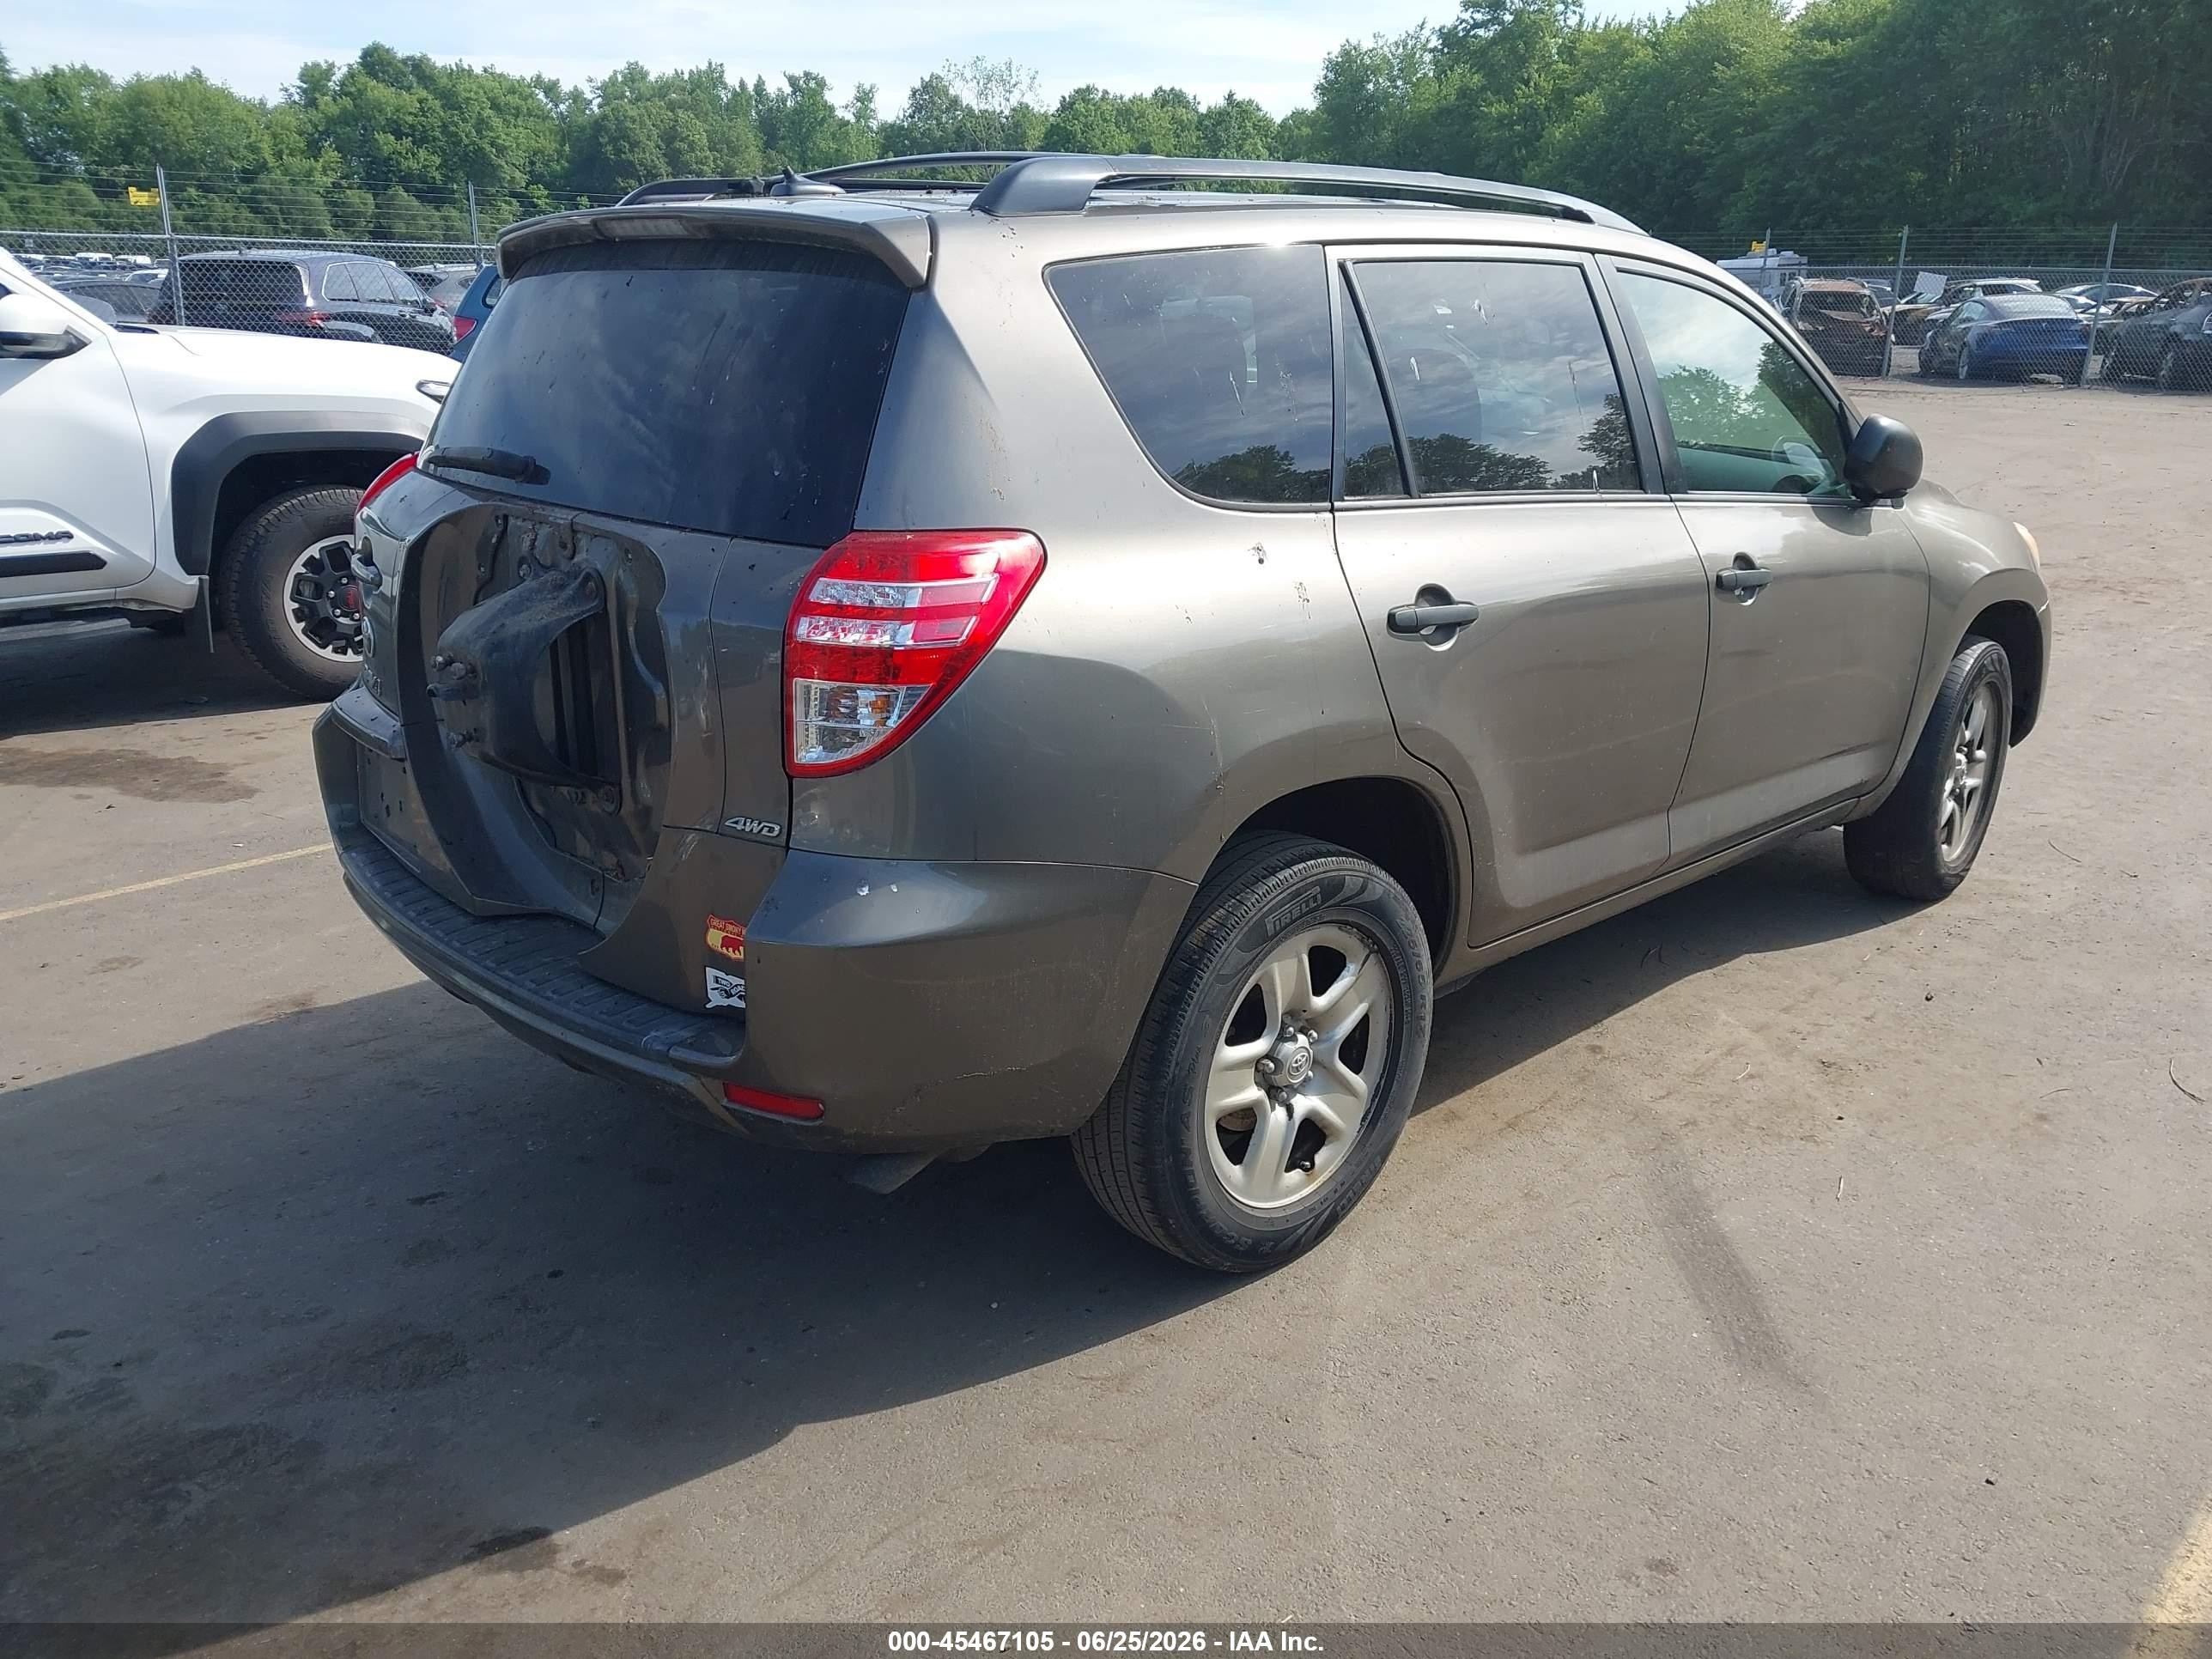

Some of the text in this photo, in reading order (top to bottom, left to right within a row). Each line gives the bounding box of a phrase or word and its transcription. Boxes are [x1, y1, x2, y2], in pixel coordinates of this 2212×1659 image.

[724, 817, 781, 837] 4WD
[1265, 885, 1322, 936] PIRELLI
[710, 918, 726, 930] GREAT
[725, 922, 742, 935] SMOKY
[717, 978, 731, 988] TWO
